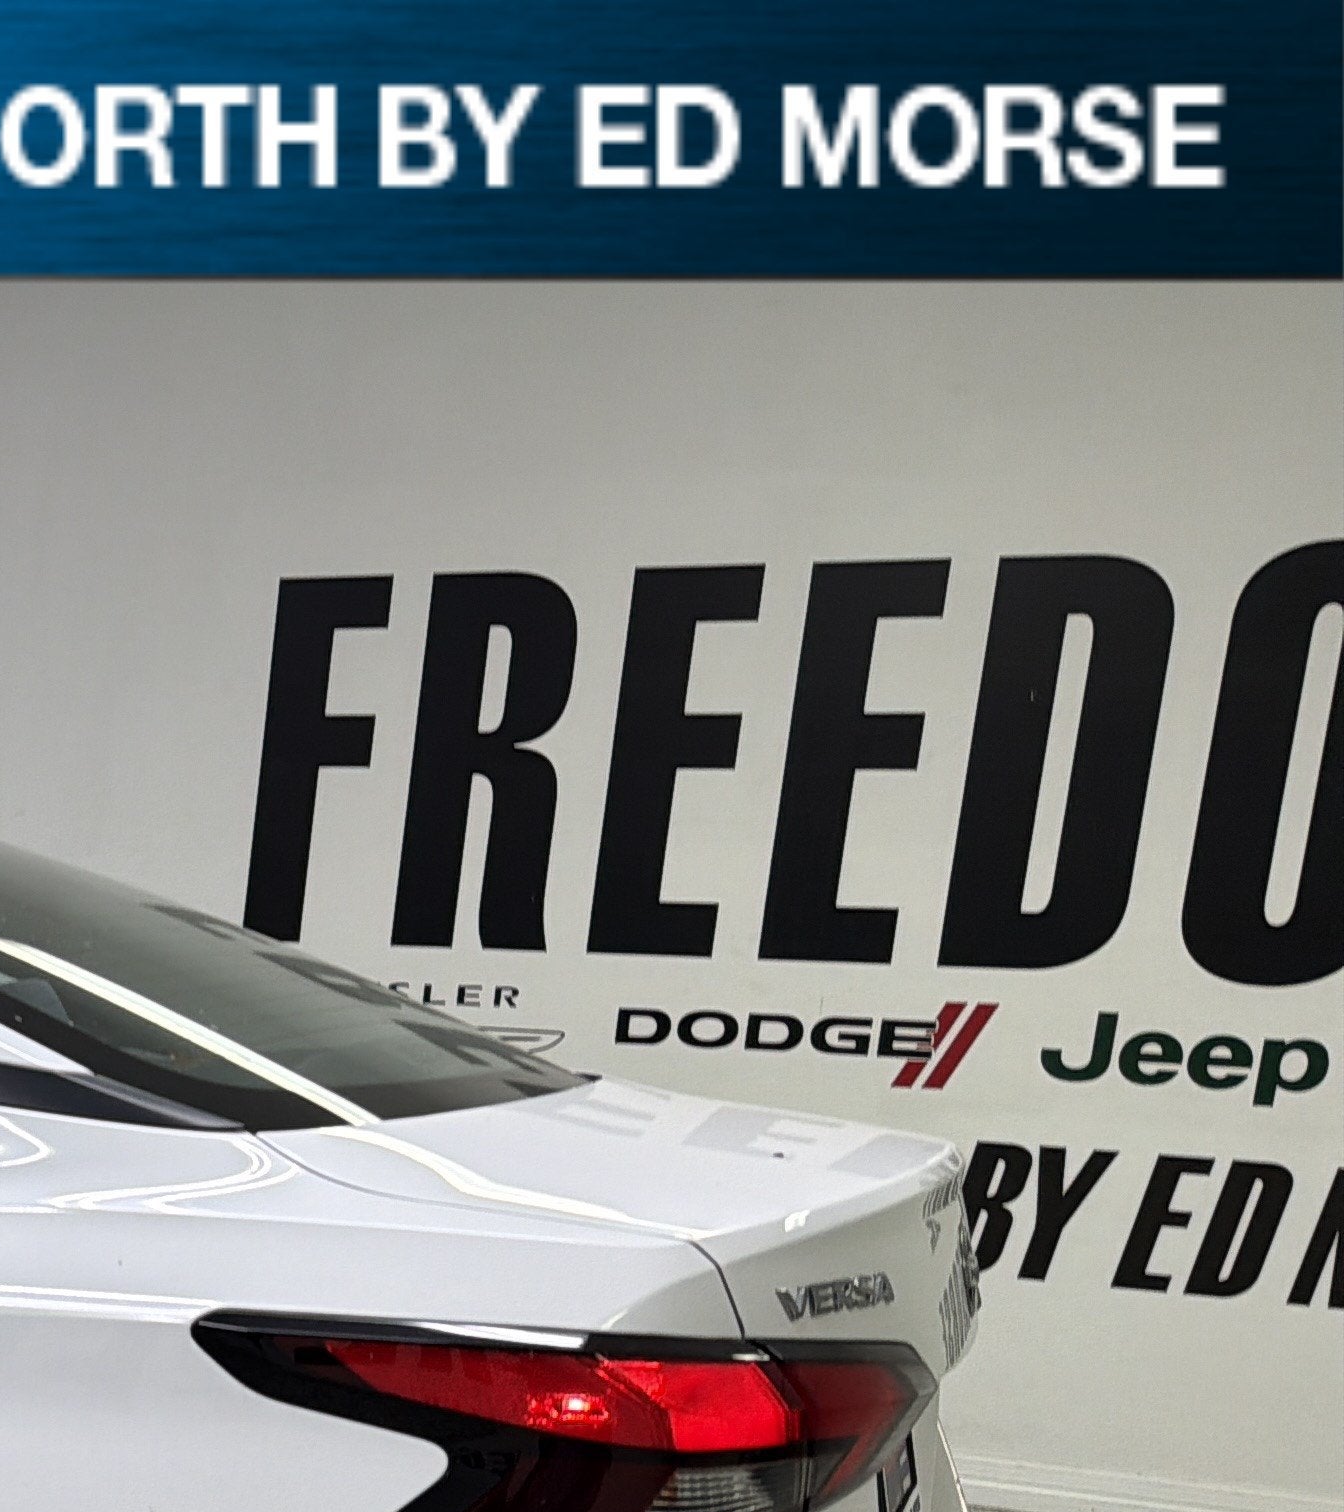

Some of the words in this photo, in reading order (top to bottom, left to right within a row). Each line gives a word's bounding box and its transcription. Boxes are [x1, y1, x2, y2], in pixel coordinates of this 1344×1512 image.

[243, 539, 1344, 987] FREEDO
[614, 1008, 937, 1061] DODGE
[1040, 1012, 1330, 1107] Jeep
[962, 1141, 1118, 1282] BY
[1112, 1154, 1294, 1298] ED
[775, 1271, 895, 1322] VERSA
